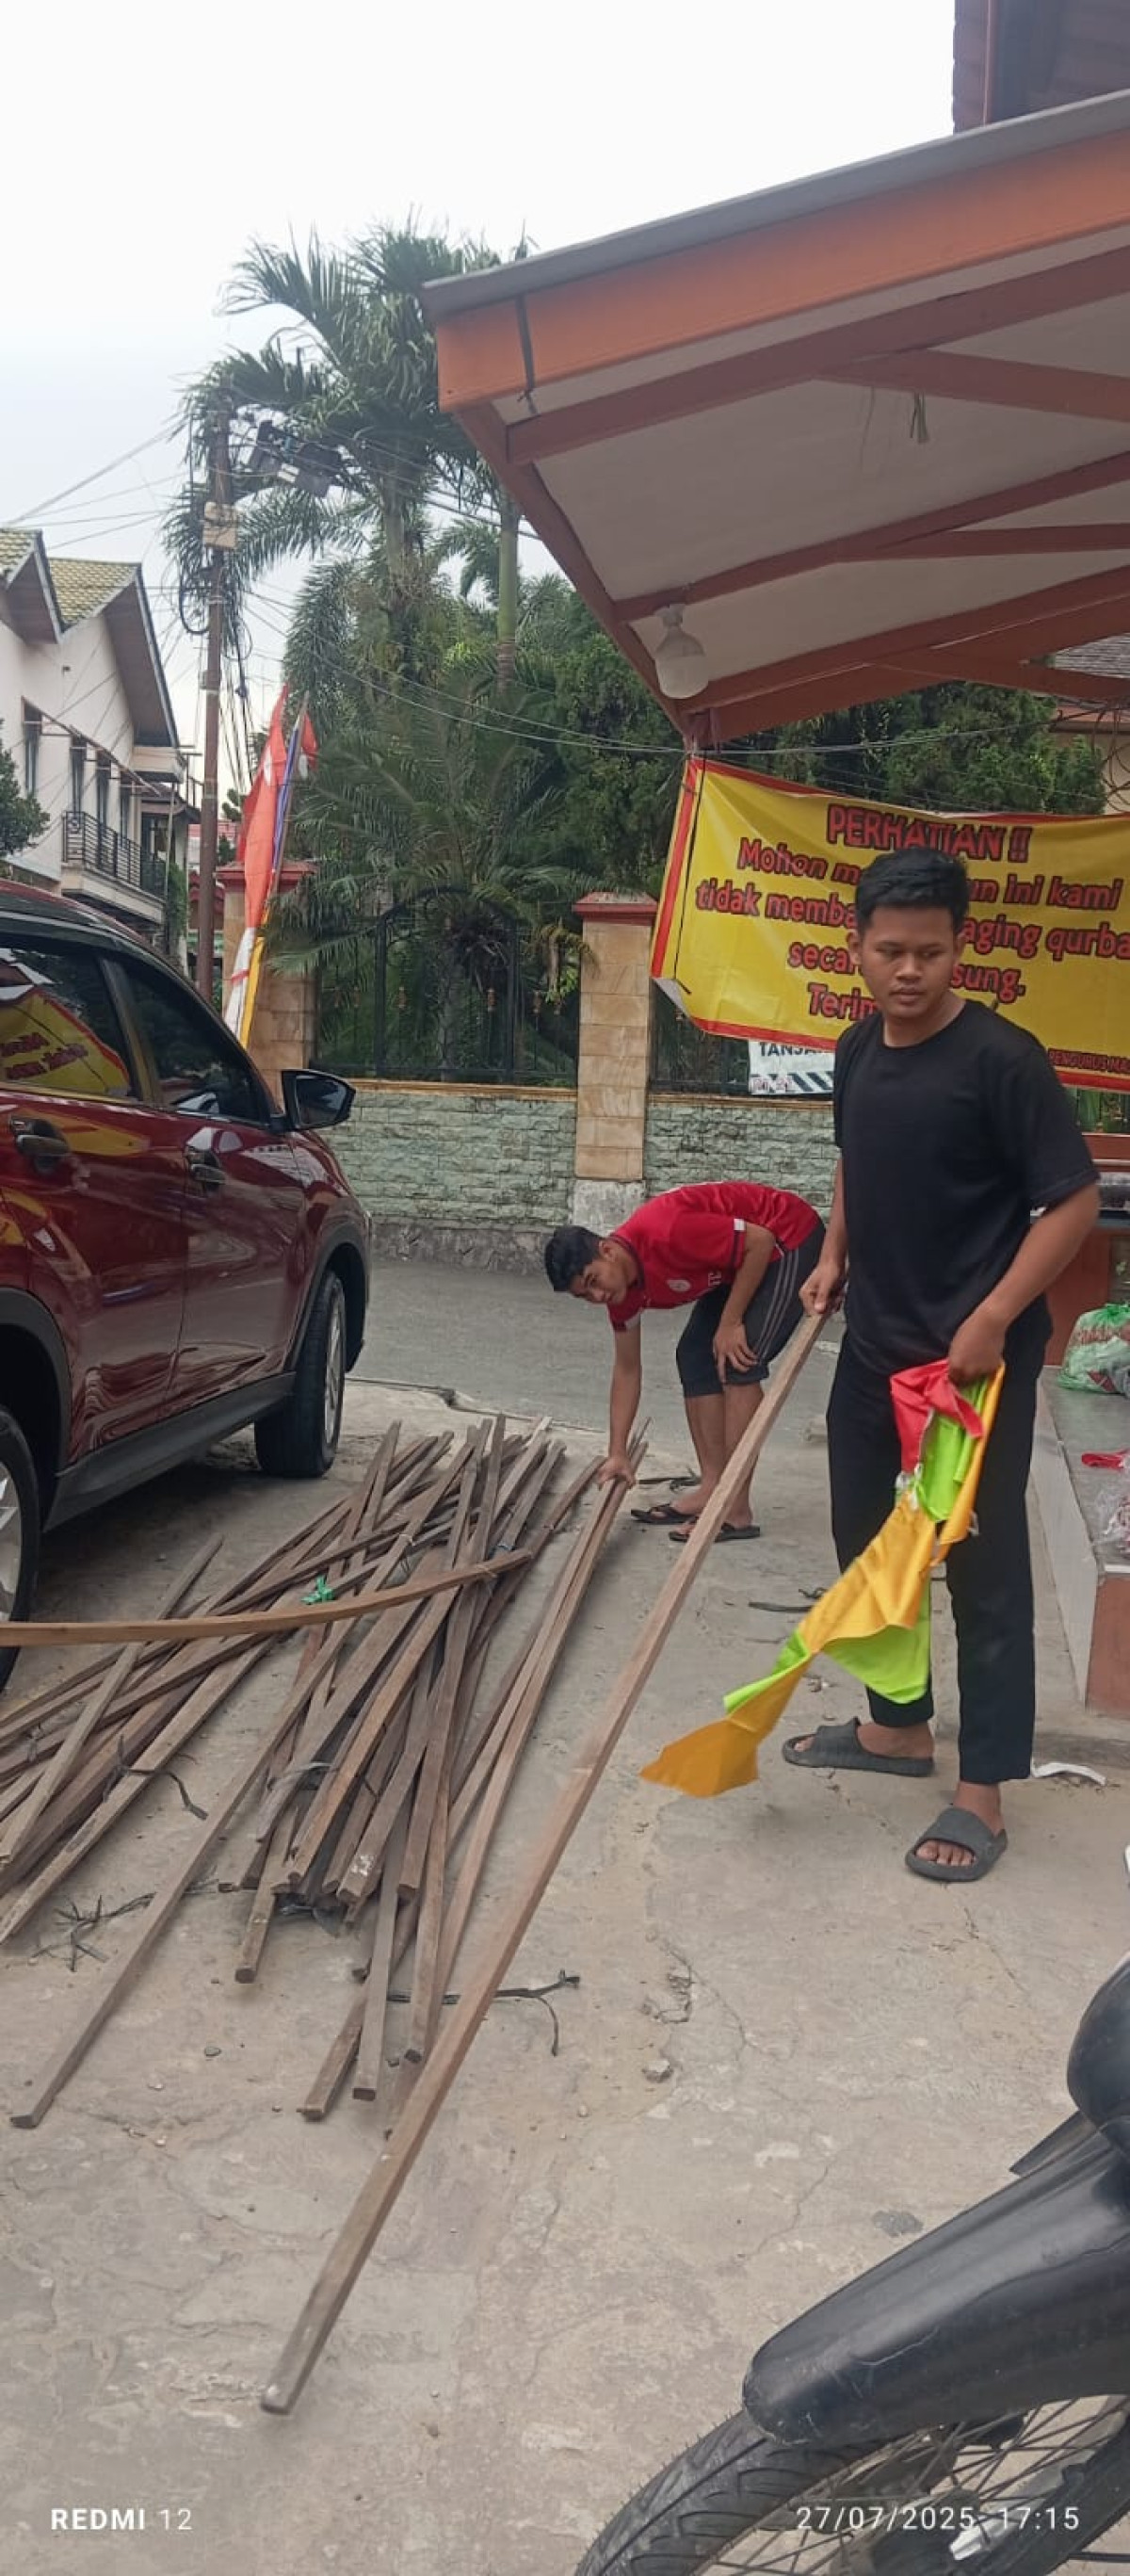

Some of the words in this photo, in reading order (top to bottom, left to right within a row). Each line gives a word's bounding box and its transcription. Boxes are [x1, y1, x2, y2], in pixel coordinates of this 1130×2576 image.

[827, 803, 1006, 861] PERHATIAN
[1008, 826, 1032, 863] !!
[737, 837, 829, 879] Mohon
[1003, 873, 1044, 905] ini
[1046, 876, 1123, 910] kami
[696, 877, 762, 916] tidak
[765, 892, 858, 929] memba
[960, 913, 1042, 960] aging
[1045, 921, 1130, 962] qurba
[787, 941, 856, 974] seca
